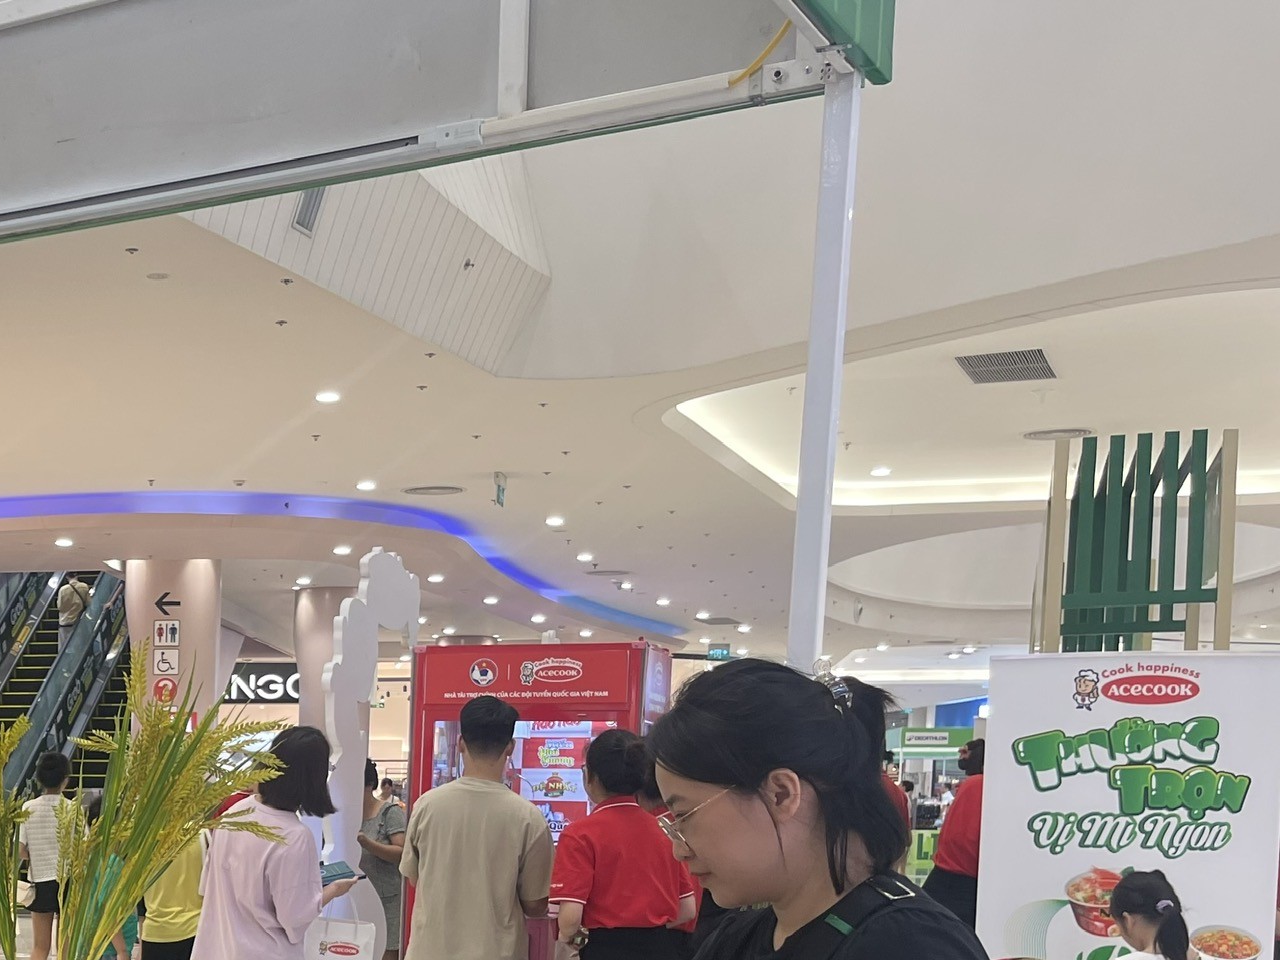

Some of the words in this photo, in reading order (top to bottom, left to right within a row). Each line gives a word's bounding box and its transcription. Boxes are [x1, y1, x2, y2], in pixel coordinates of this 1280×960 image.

[537, 669, 579, 677] ACECOOK
[1101, 664, 1134, 679] Cook
[1137, 662, 1201, 680] happiness
[224, 672, 301, 700] NG
[1107, 684, 1194, 697] ACECOOK
[1109, 764, 1252, 821] TRỌN
[1027, 812, 1078, 855] Vị
[1138, 812, 1233, 860] Ngon
